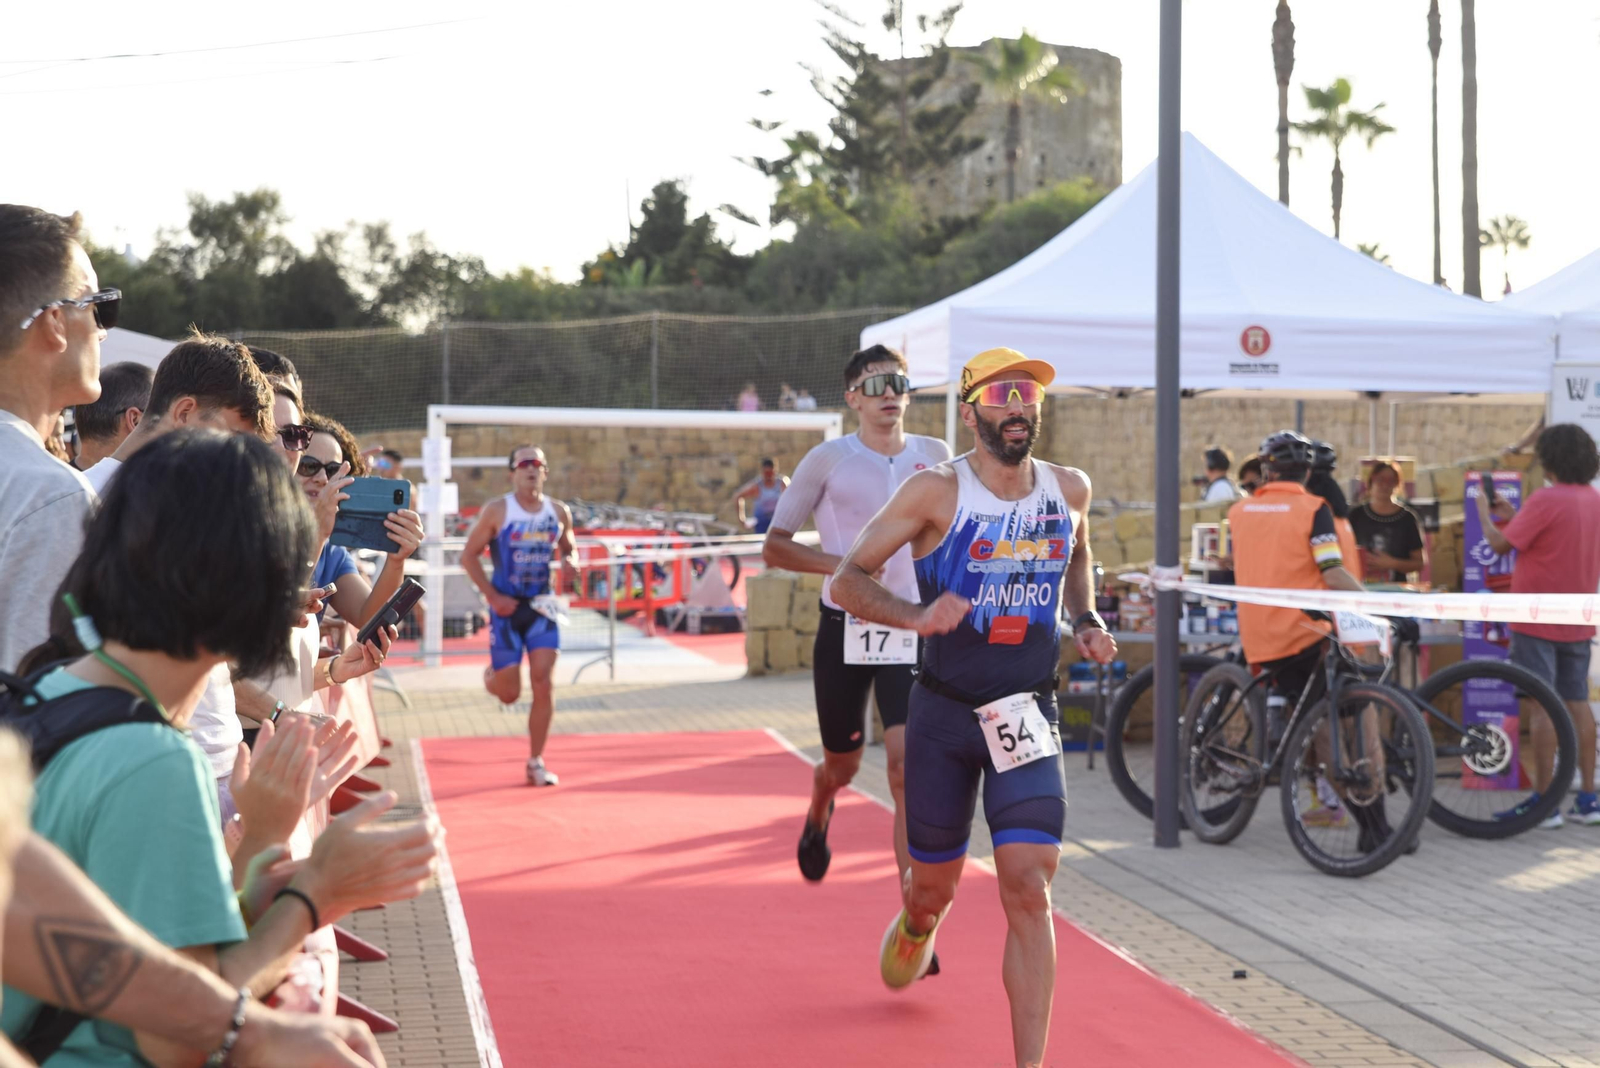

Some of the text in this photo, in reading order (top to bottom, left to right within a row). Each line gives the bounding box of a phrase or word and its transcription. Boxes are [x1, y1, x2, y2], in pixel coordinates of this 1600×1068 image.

[967, 560, 1026, 574] COSTA
[971, 582, 1052, 607] JANDRO
[860, 630, 891, 652] 17
[996, 717, 1035, 753] 54
